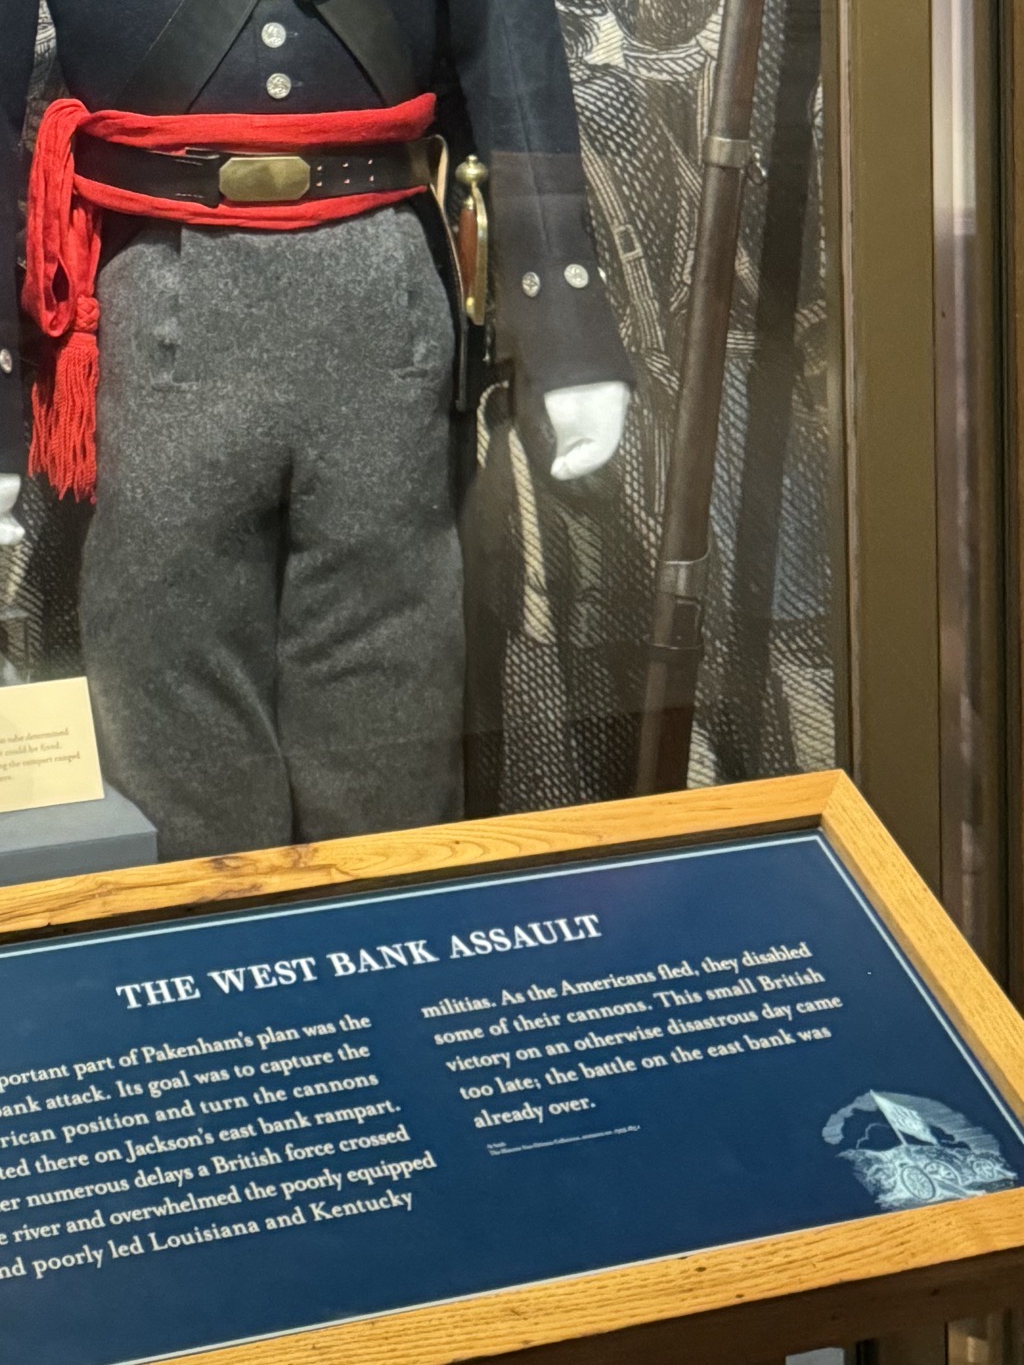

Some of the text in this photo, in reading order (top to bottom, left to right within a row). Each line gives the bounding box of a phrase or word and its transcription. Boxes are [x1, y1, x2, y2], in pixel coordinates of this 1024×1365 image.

[115, 914, 602, 1009] THE WEST BANK ASSAULT
[421, 942, 813, 1018] militias. As the Americans fled, they disabled
[434, 967, 826, 1045] some of their cannons. This small British
[445, 997, 843, 1072] victory on an otherwise disastrous day came
[45, 1084, 112, 1110] attack.
[115, 1080, 144, 1098] Its
[147, 1070, 191, 1098] goal
[193, 1069, 230, 1084] was
[233, 1065, 255, 1078] to
[260, 1052, 334, 1076] capture
[337, 1043, 370, 1061] the
[73, 1057, 115, 1081] part
[118, 1048, 139, 1067] of
[141, 1031, 254, 1063] Pakenham's
[256, 1026, 300, 1050] plan
[301, 1023, 337, 1037] was
[339, 1014, 372, 1031] the
[459, 1027, 832, 1100] too late; the battle on the east bank was
[34, 1154, 90, 1173] there
[94, 1148, 123, 1163] on
[124, 1127, 215, 1163] Jackson's
[218, 1124, 257, 1142] east
[257, 1111, 312, 1134] bank
[314, 1100, 401, 1125] rampart.
[61, 1113, 150, 1143] position
[155, 1099, 196, 1122] and
[199, 1096, 249, 1114] turn
[253, 1086, 288, 1105] the
[293, 1074, 379, 1098] cannons
[473, 1098, 596, 1128] already over.
[12, 1223, 61, 1243] river
[66, 1209, 106, 1233] and
[109, 1184, 242, 1225] overwhelmed
[244, 1181, 278, 1201] the
[280, 1168, 342, 1200] poorly
[346, 1150, 437, 1186] equipped
[25, 1179, 130, 1207] numerous
[134, 1166, 194, 1188] delays
[197, 1165, 210, 1177] a
[210, 1147, 282, 1174] British
[285, 1142, 335, 1161] force
[339, 1123, 411, 1152] crossed
[32, 1244, 103, 1279] poorly
[107, 1235, 145, 1258] led
[148, 1221, 260, 1251] Louisiana
[265, 1205, 307, 1230] and
[309, 1189, 412, 1221] Kentucky
